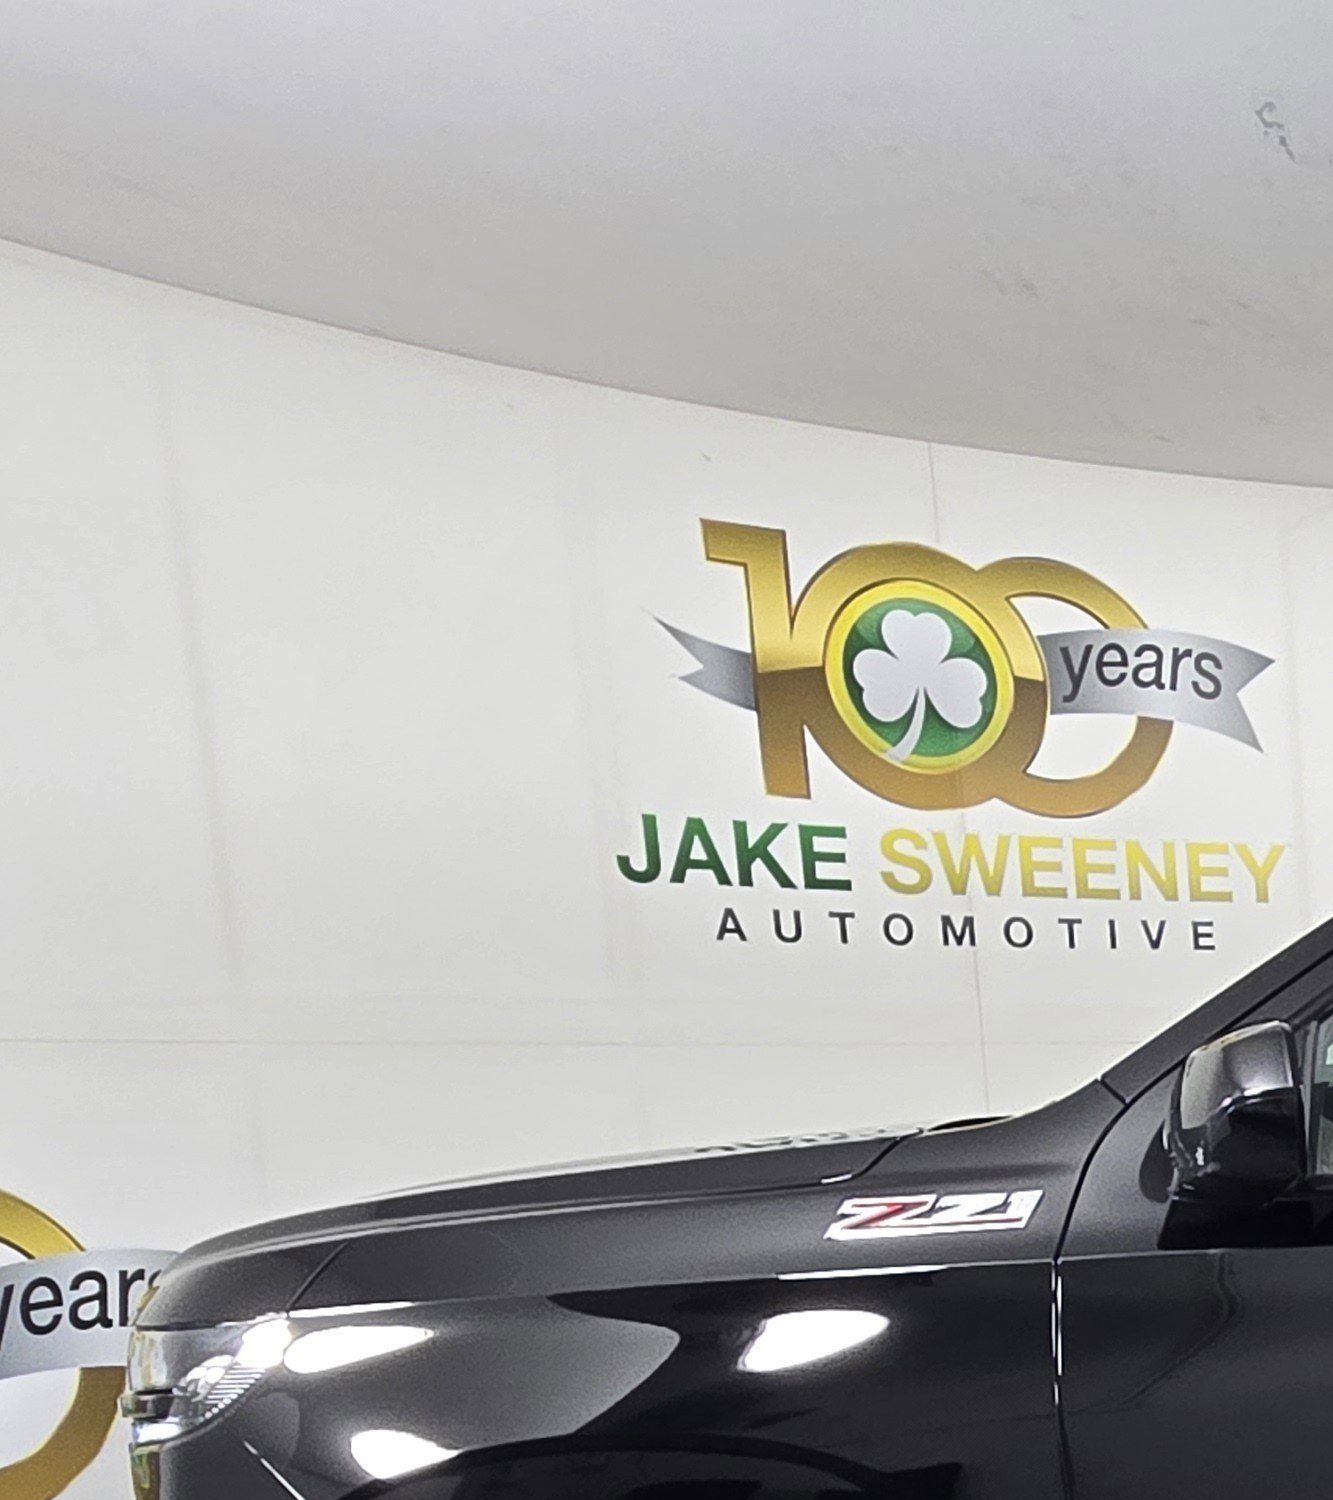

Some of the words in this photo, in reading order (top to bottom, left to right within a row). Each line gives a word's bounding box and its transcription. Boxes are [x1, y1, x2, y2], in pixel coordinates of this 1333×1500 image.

[699, 518, 1174, 819] 100
[1059, 638, 1224, 702] years
[616, 813, 853, 892] JAKE
[879, 828, 1287, 904] SWEENEY
[715, 907, 1217, 952] AUTOMOTIVE
